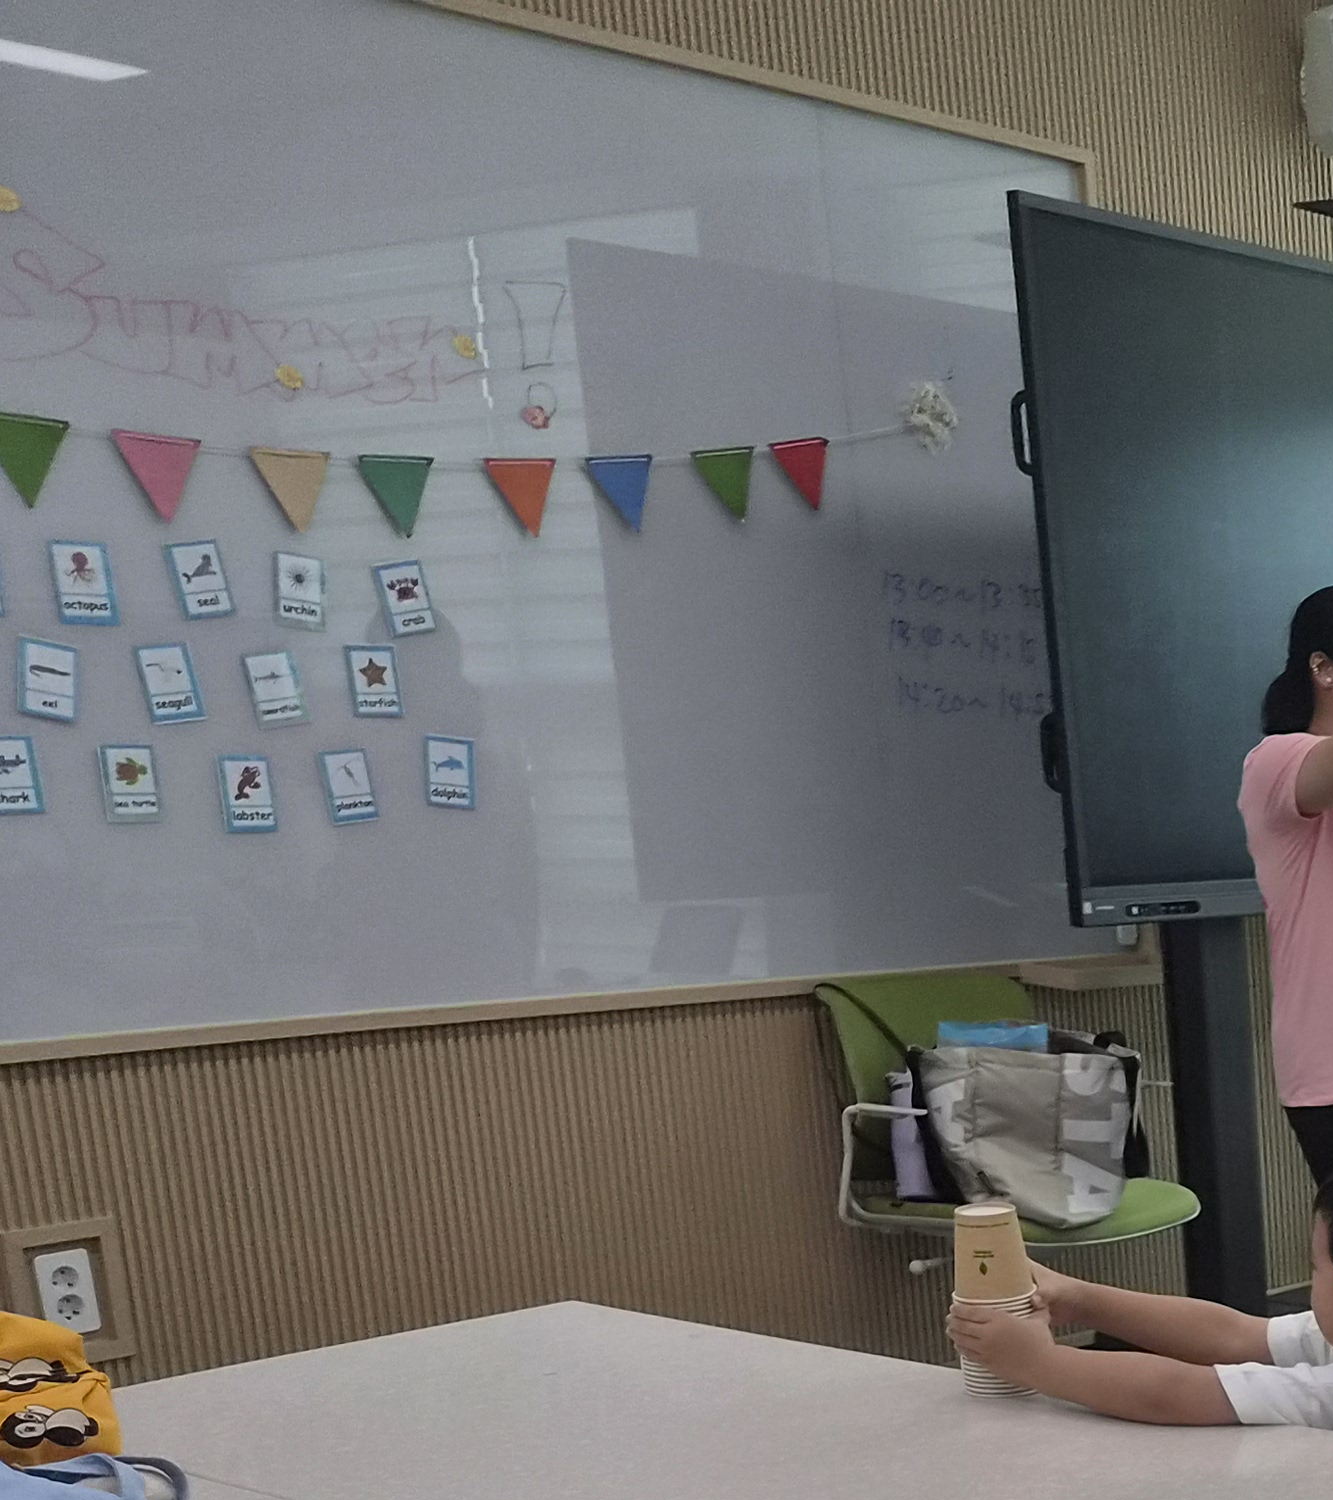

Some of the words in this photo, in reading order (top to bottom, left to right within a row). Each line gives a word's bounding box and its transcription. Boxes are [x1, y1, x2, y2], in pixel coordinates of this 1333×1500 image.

[63, 599, 109, 612] octopus
[197, 594, 221, 607] seal
[282, 603, 318, 617] urchin
[402, 614, 426, 627] crab
[155, 695, 194, 711] seagull
[358, 697, 398, 708] starfish
[0, 791, 31, 804] hark
[431, 786, 468, 801] dolphin
[232, 810, 273, 821] lobster
